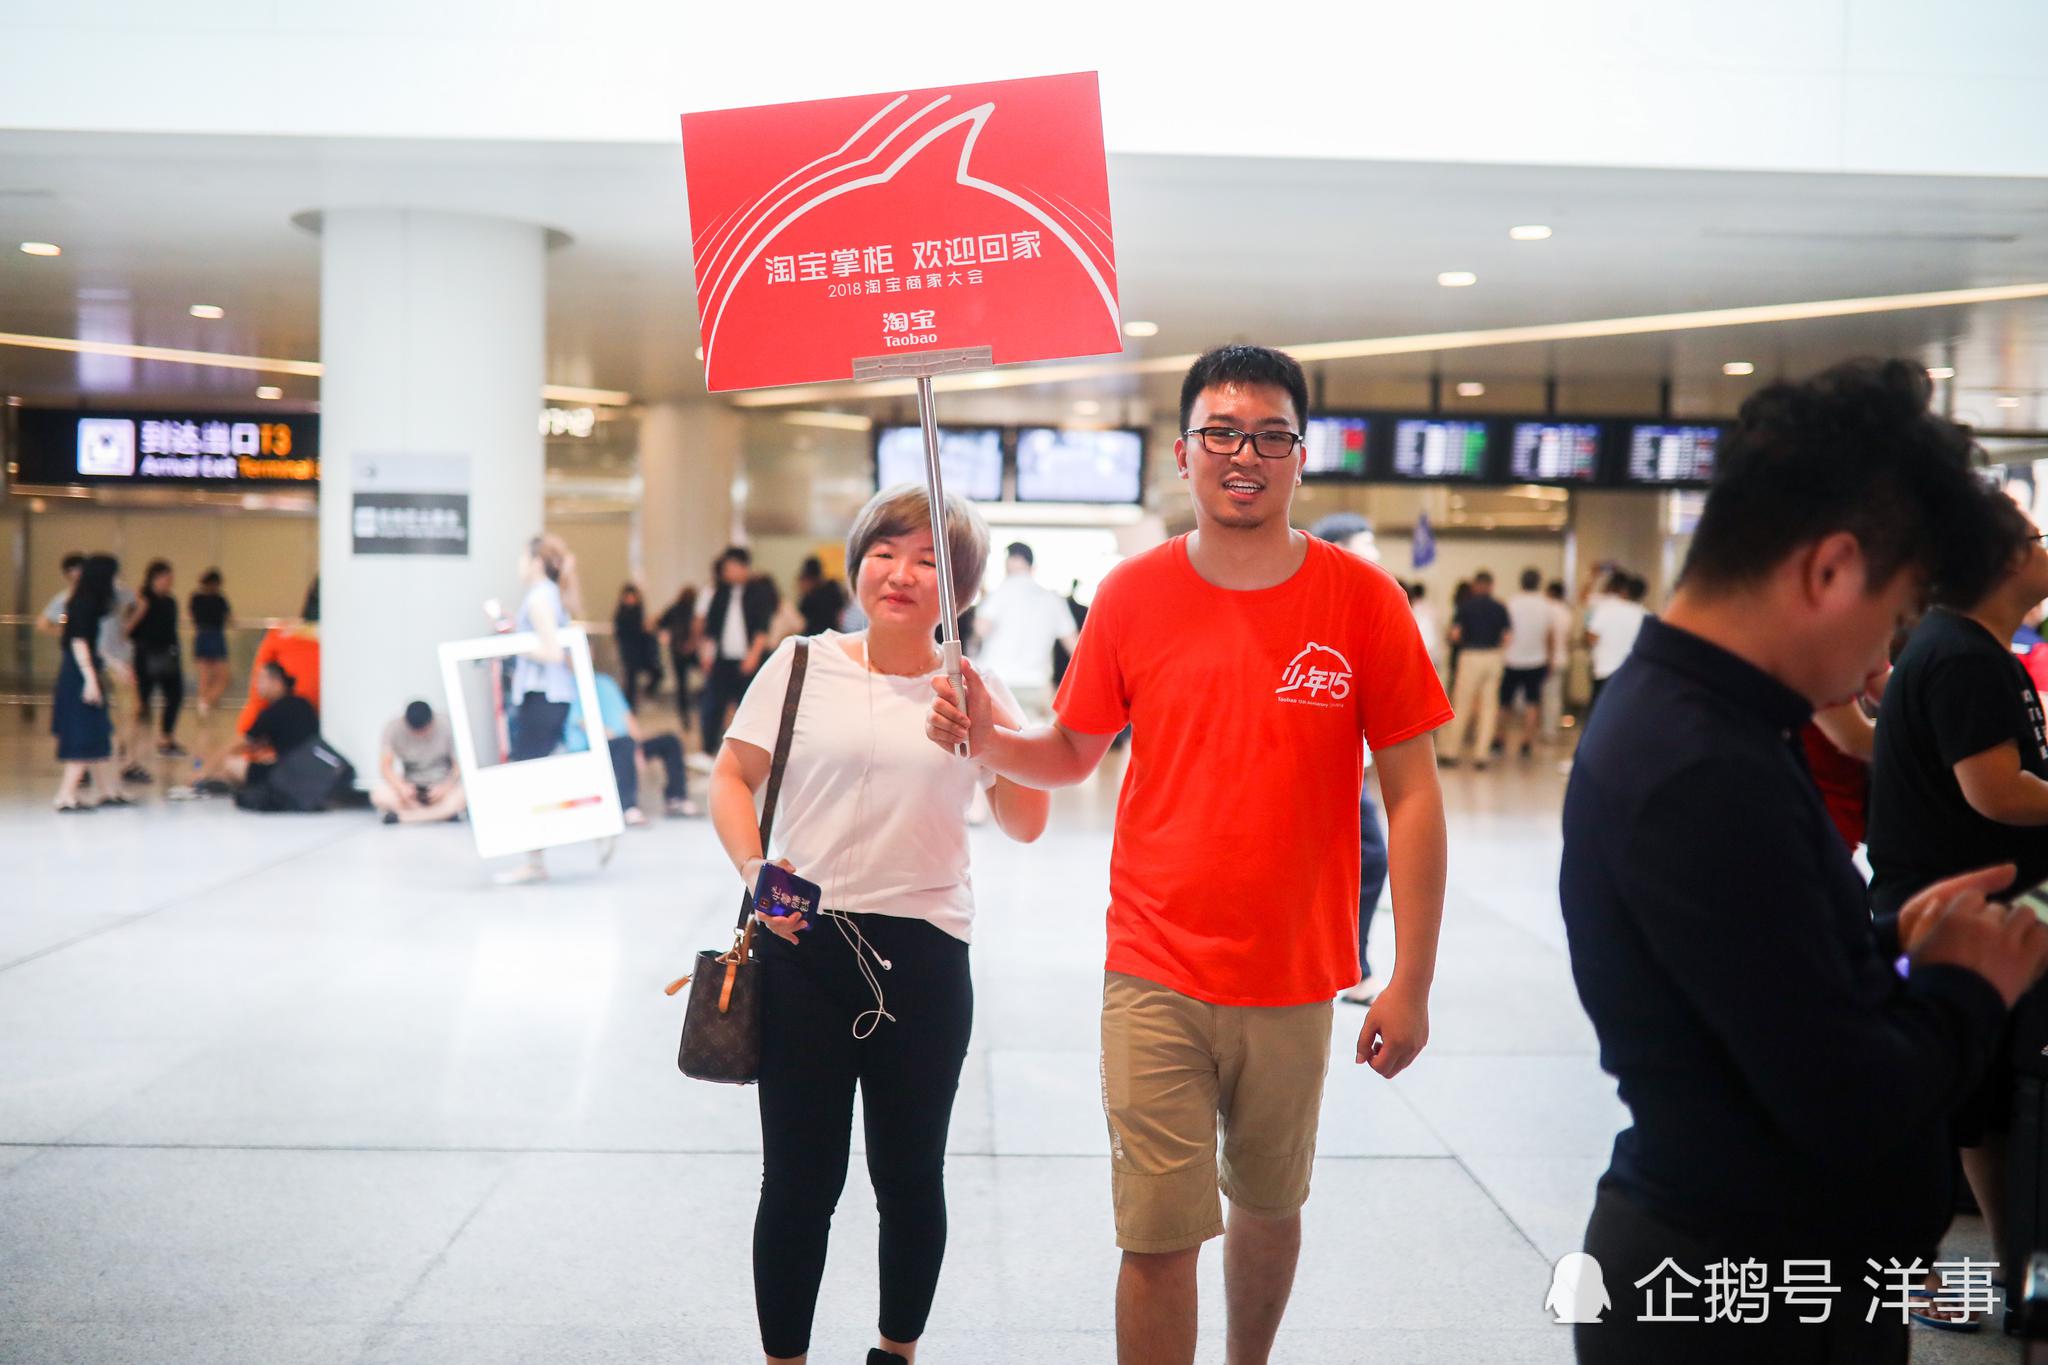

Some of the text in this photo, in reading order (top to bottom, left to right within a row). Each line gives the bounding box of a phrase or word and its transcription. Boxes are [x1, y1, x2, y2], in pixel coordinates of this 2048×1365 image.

[764, 231, 1041, 285] 淘宝掌柜 欢迎回家
[882, 309, 936, 333] 淘宝
[884, 333, 938, 348] Taobao
